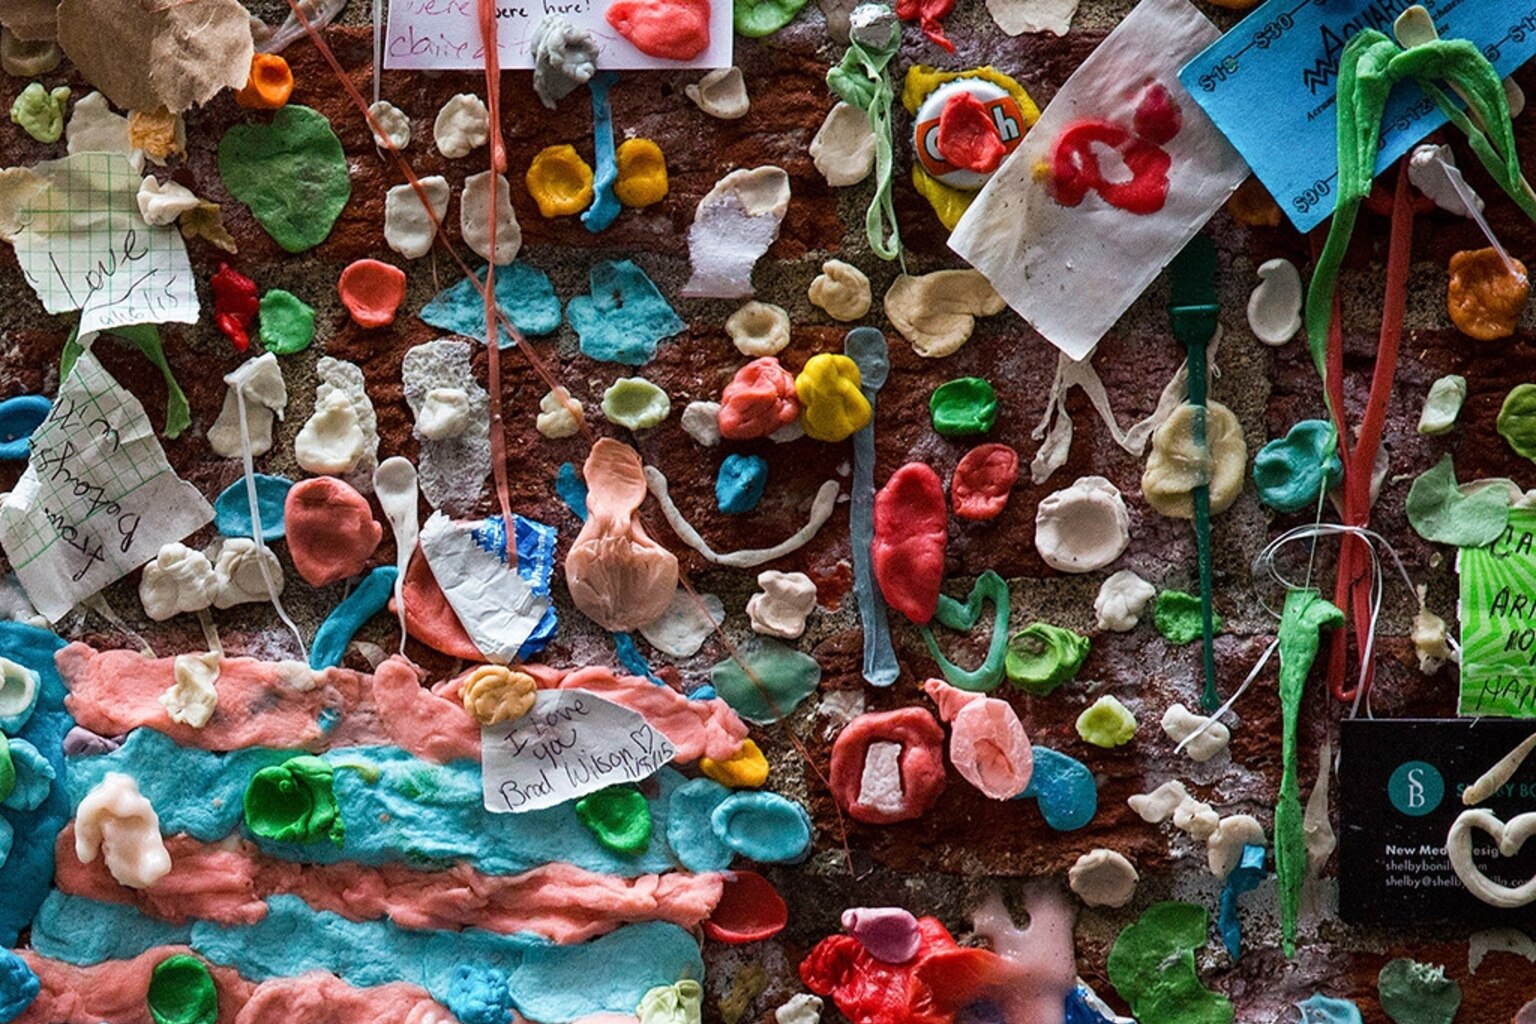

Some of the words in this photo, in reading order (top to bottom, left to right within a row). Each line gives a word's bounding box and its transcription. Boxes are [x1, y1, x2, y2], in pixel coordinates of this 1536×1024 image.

[1252, 13, 1294, 49] $30
[1291, 180, 1331, 214] $90
[564, 747, 634, 788] Wilson
[1385, 844, 1416, 856] New
